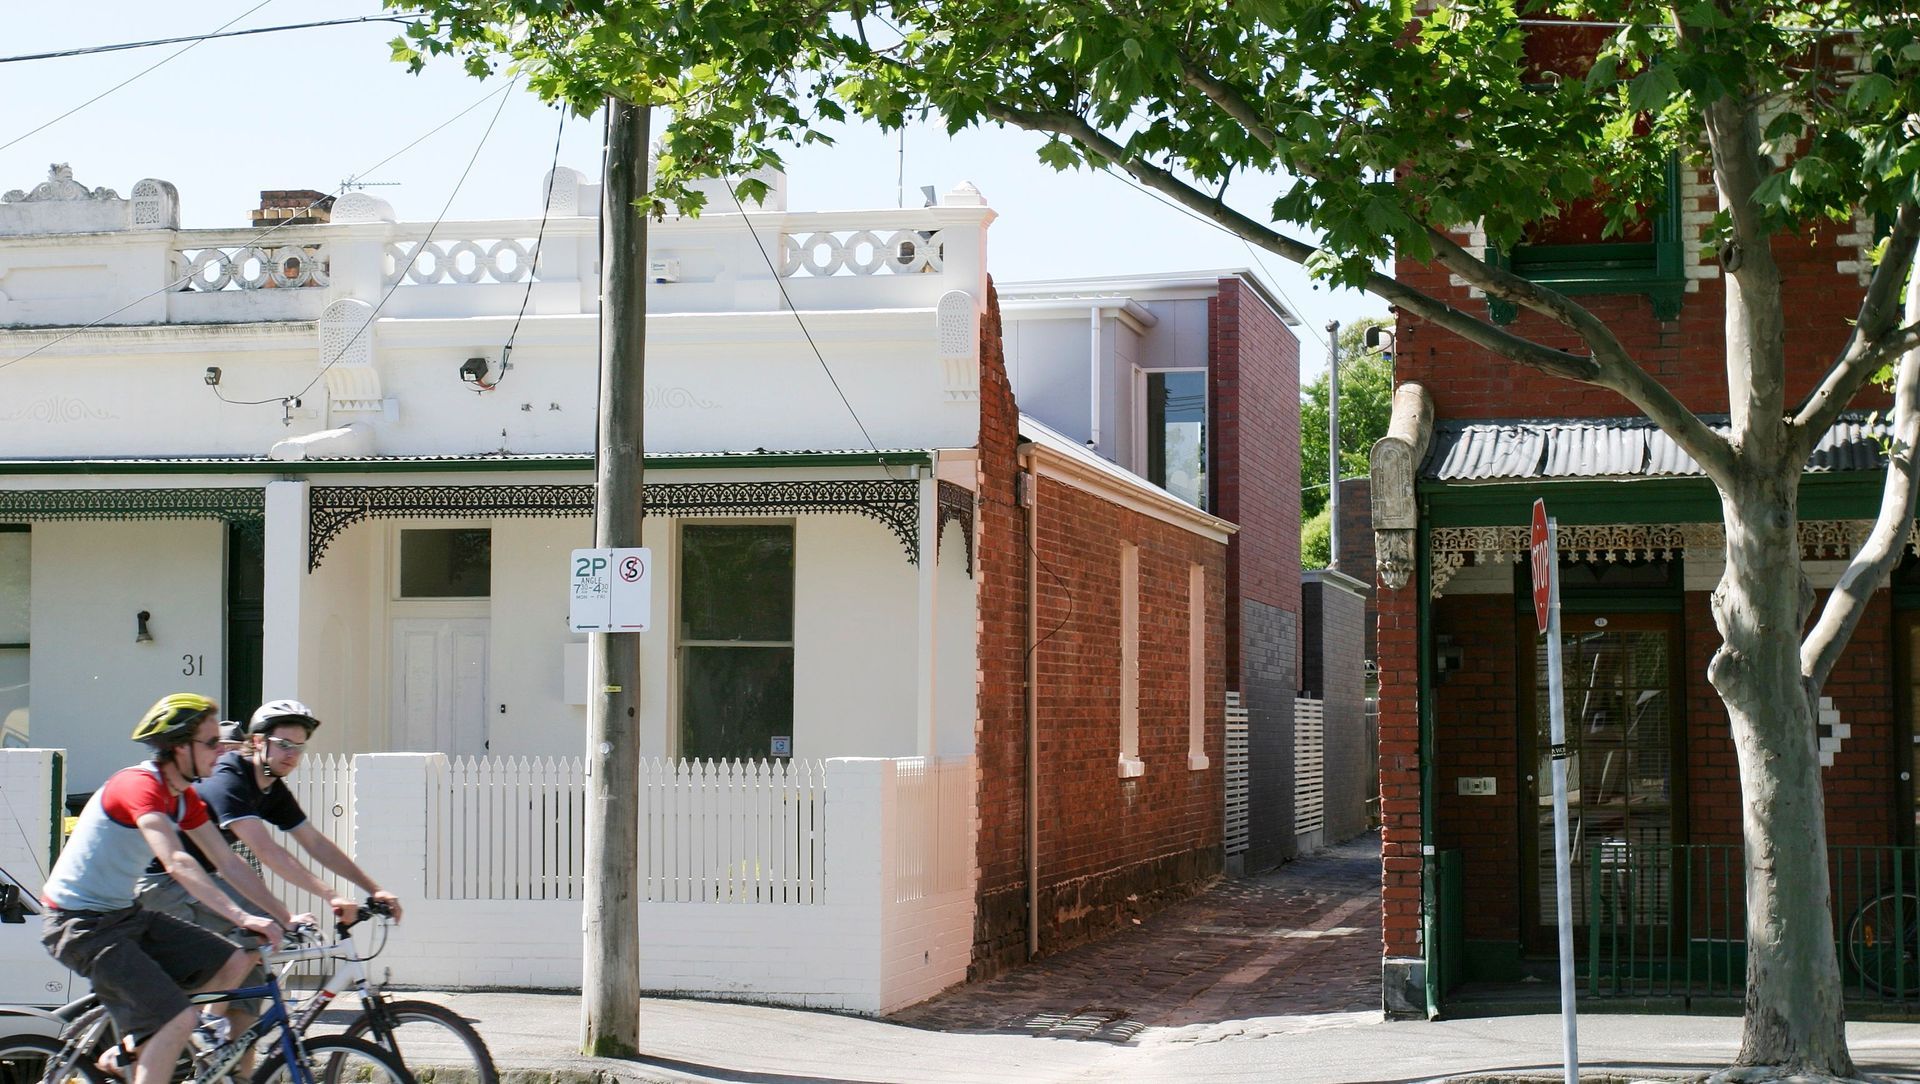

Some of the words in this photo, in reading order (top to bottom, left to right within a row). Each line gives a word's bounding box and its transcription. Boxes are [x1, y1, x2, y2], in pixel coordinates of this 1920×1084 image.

[575, 557, 607, 577] 2P
[625, 560, 638, 579] S
[1532, 540, 1549, 592] STOP
[580, 577, 602, 585] ANGLE
[182, 654, 203, 676] 31
